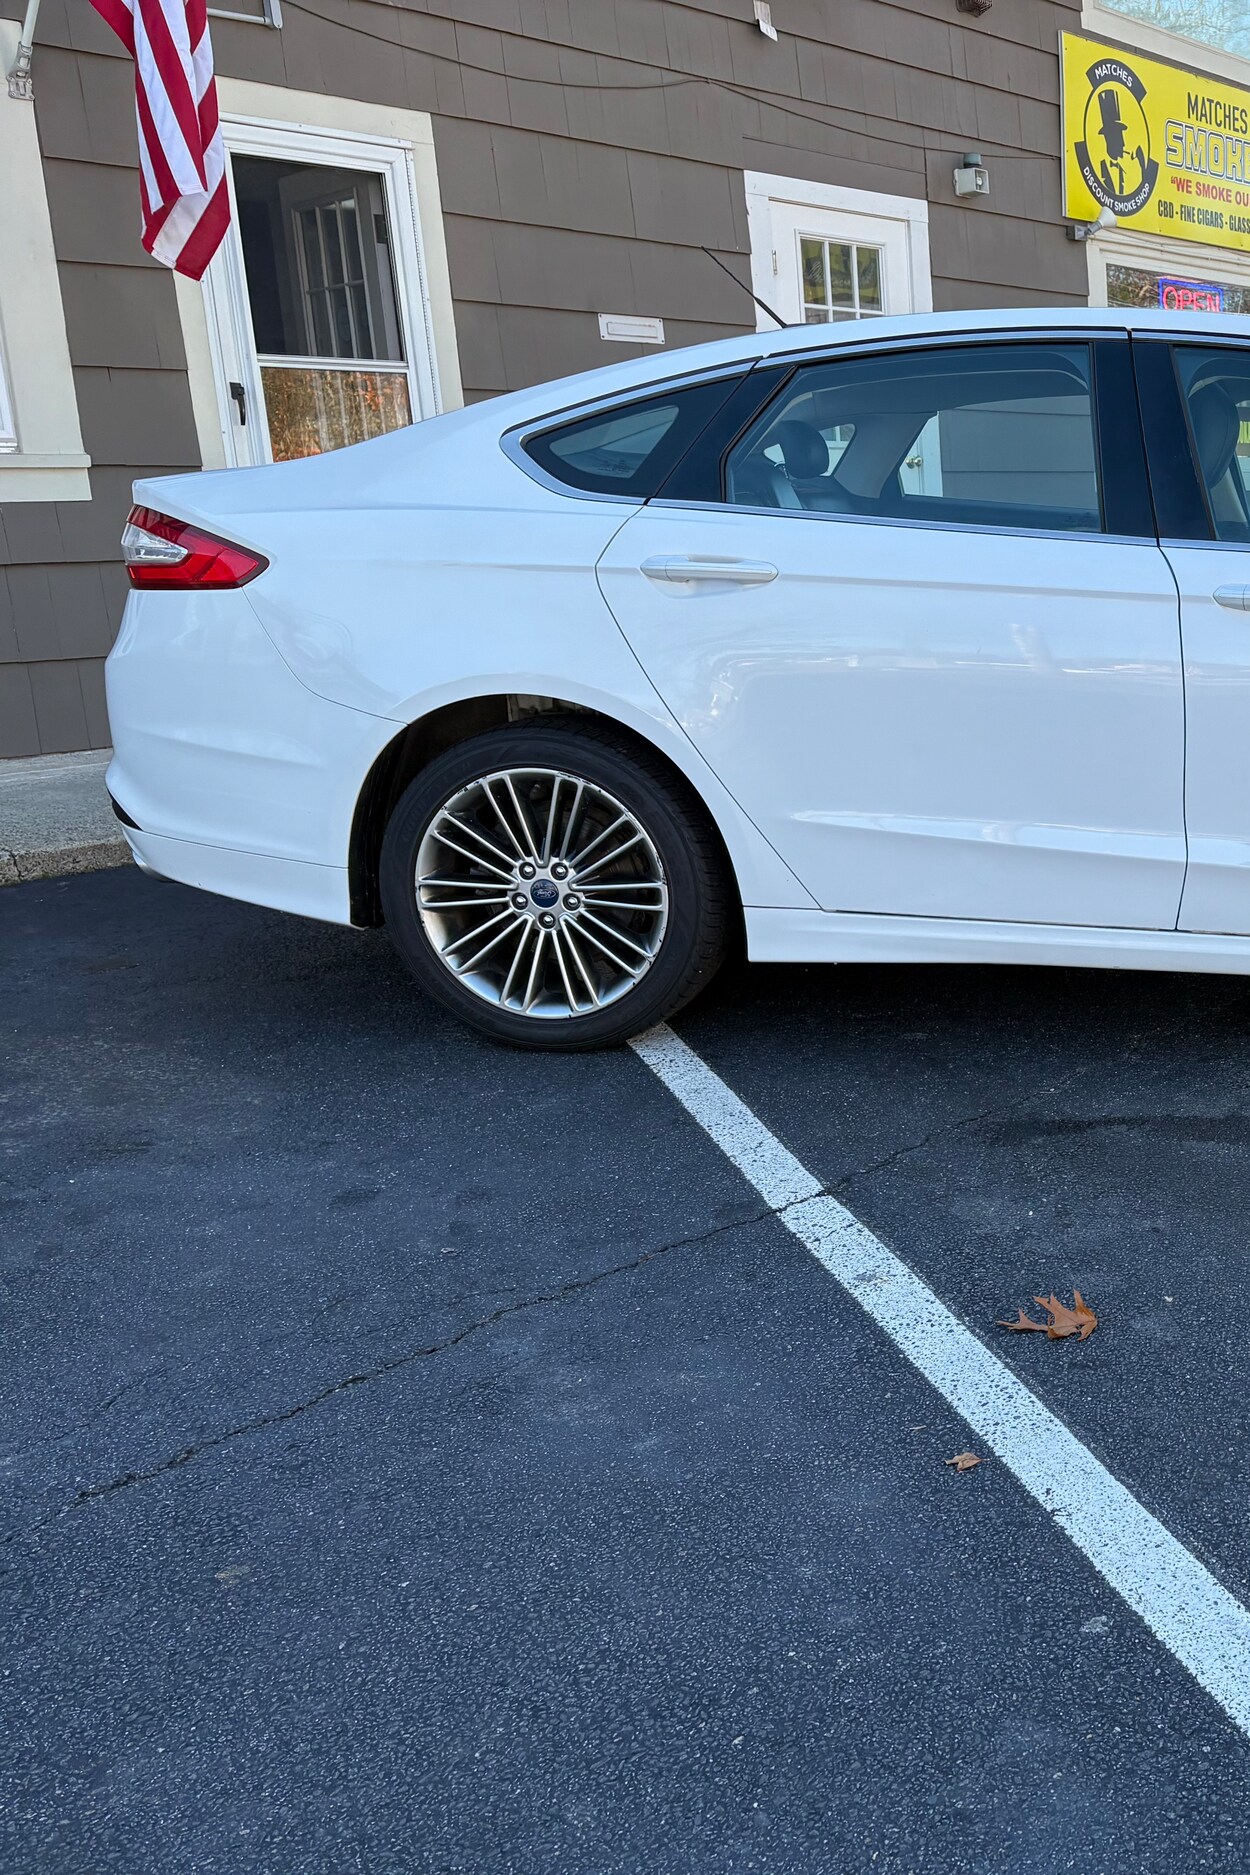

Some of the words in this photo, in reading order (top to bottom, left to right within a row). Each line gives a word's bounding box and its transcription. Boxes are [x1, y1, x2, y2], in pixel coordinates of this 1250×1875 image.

[1094, 63, 1133, 87] MATCHES
[1187, 92, 1248, 135] MATCHES
[1083, 166, 1114, 208] DISCOUNT
[1113, 199, 1137, 213] SMOKE
[1135, 183, 1151, 207] SHOP
[1195, 181, 1232, 204] SMOKE
[1157, 199, 1174, 219] CBD
[1180, 204, 1196, 224] FINE
[1197, 207, 1224, 230] CIGARS
[1228, 214, 1250, 235] GLASS
[1162, 286, 1220, 313] OPEN
